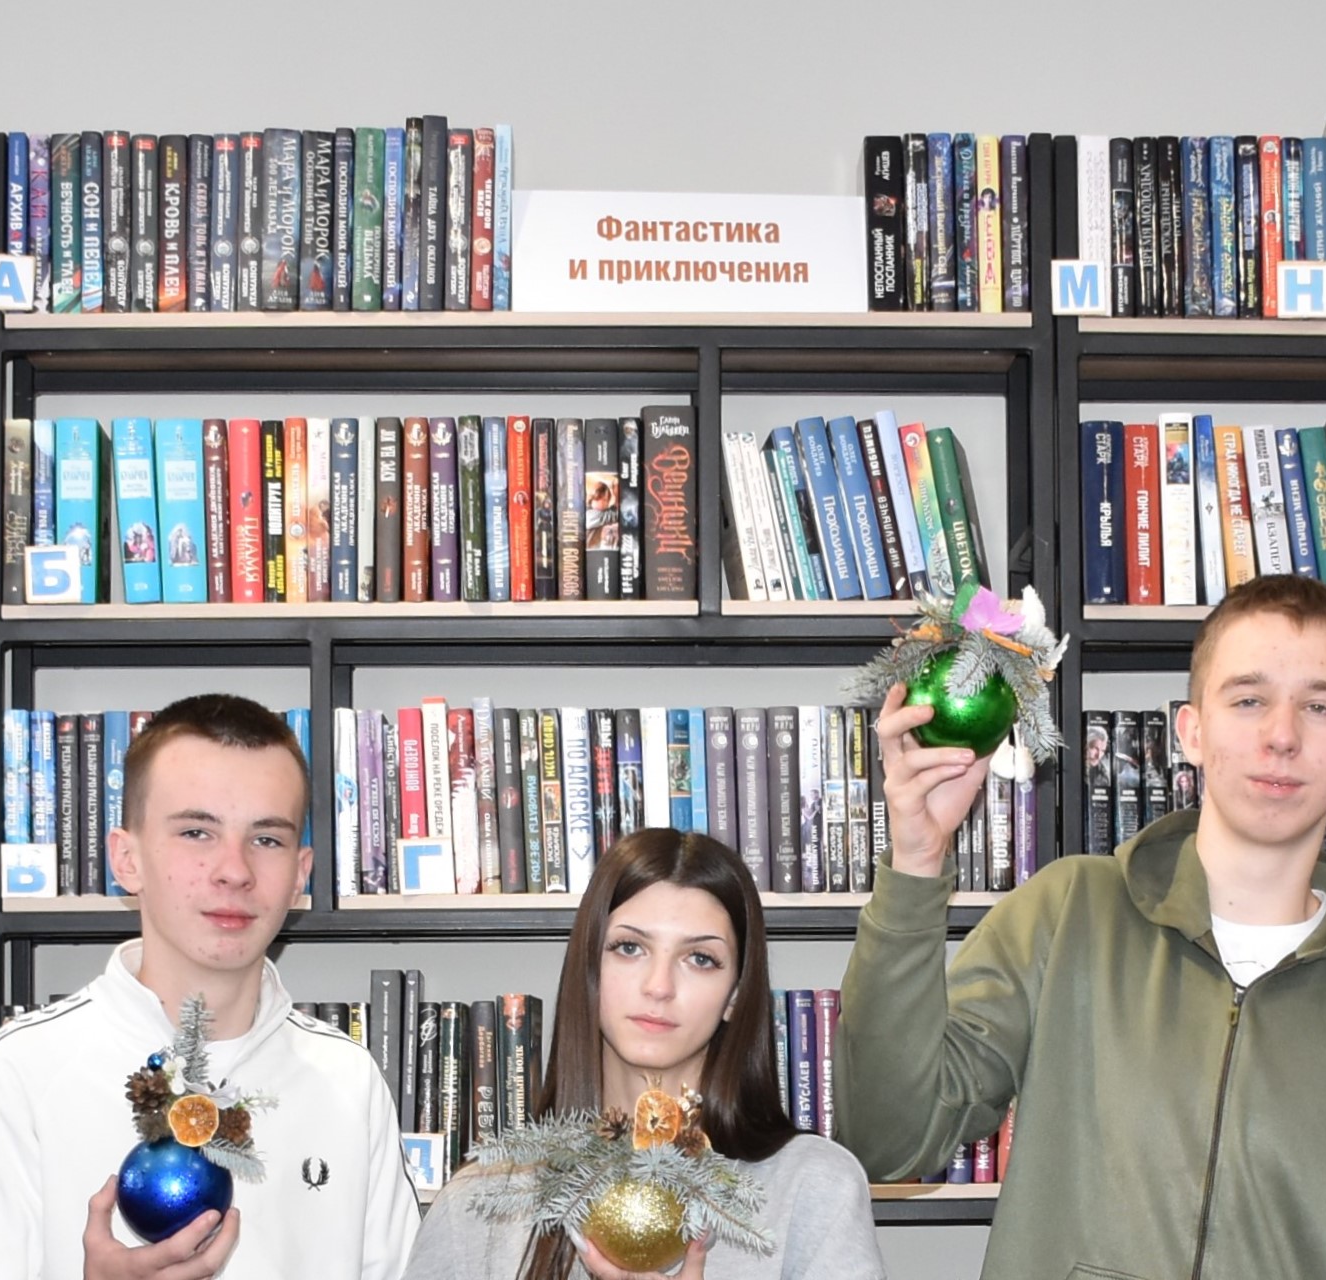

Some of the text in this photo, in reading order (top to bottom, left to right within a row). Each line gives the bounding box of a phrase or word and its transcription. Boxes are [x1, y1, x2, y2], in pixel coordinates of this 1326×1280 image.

[337, 161, 346, 288] ГОСПОДИН МОИХ НОЧЕЙ
[387, 161, 396, 288] ГОСПОДИН МОИХ НОЧЕЙ
[427, 187, 438, 284] ТАЙНА ДВУХ ОКЕАНОВ
[597, 215, 781, 244] Фантастика
[1140, 164, 1153, 267] ВРЕМЯ МОЛОДЫХ
[568, 259, 809, 285] и приключения
[872, 228, 884, 299] НЕПОСЛАННЫЙ
[886, 234, 895, 292] ПОСЛАННИК
[1059, 265, 1099, 308] М
[1283, 269, 1325, 312] Н
[1096, 433, 1106, 464] СТАРК
[1133, 436, 1143, 467] СТАРК
[1223, 432, 1246, 557] СТРАХ НИКОГДА НЕ СТАРЕЕТ
[244, 516, 259, 583] ПЛАМЯ
[952, 521, 973, 581] ЦВЕТОК
[1100, 502, 1111, 547] КРЫЛЬЯ
[1137, 490, 1150, 567] ГОНЧИЕ ЛИЛИТ
[31, 553, 69, 595] Б
[405, 739, 420, 792] ВОНГОЗЕРО
[429, 723, 443, 836] ПОСЕЛОК НА РЕКЕ ОРЕДЕЖ
[405, 845, 442, 889] Г
[798, 1061, 811, 1112] БУСЛАЕВ
